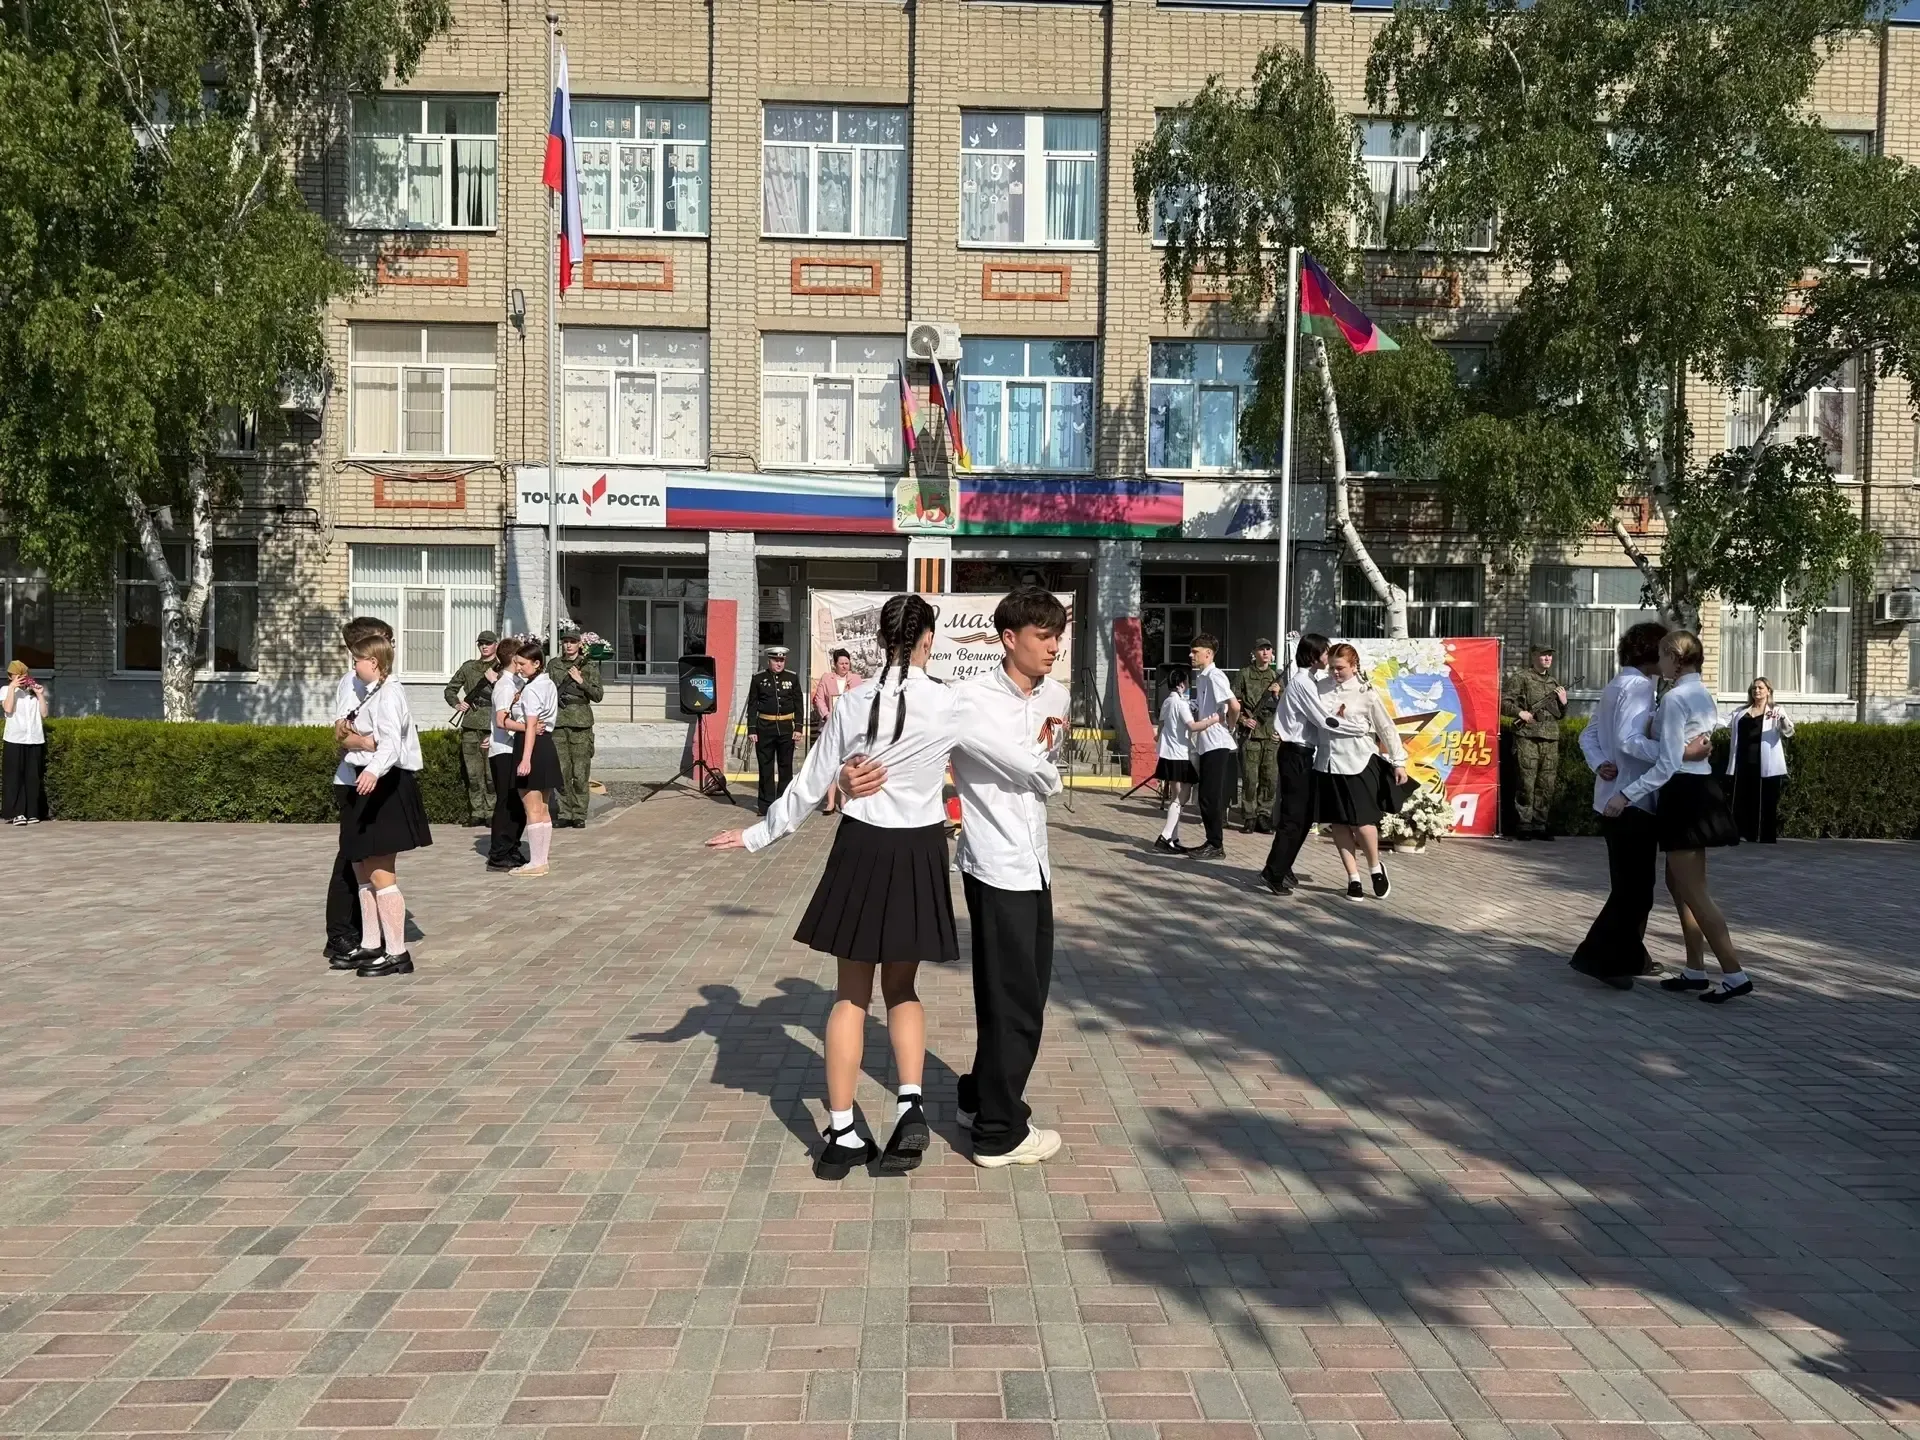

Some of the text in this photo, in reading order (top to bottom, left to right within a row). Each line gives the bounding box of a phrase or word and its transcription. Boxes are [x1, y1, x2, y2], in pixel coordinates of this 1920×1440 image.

[607, 493, 661, 507] РОСТА
[1440, 730, 1487, 749] 1941
[1442, 748, 1493, 767] 1945
